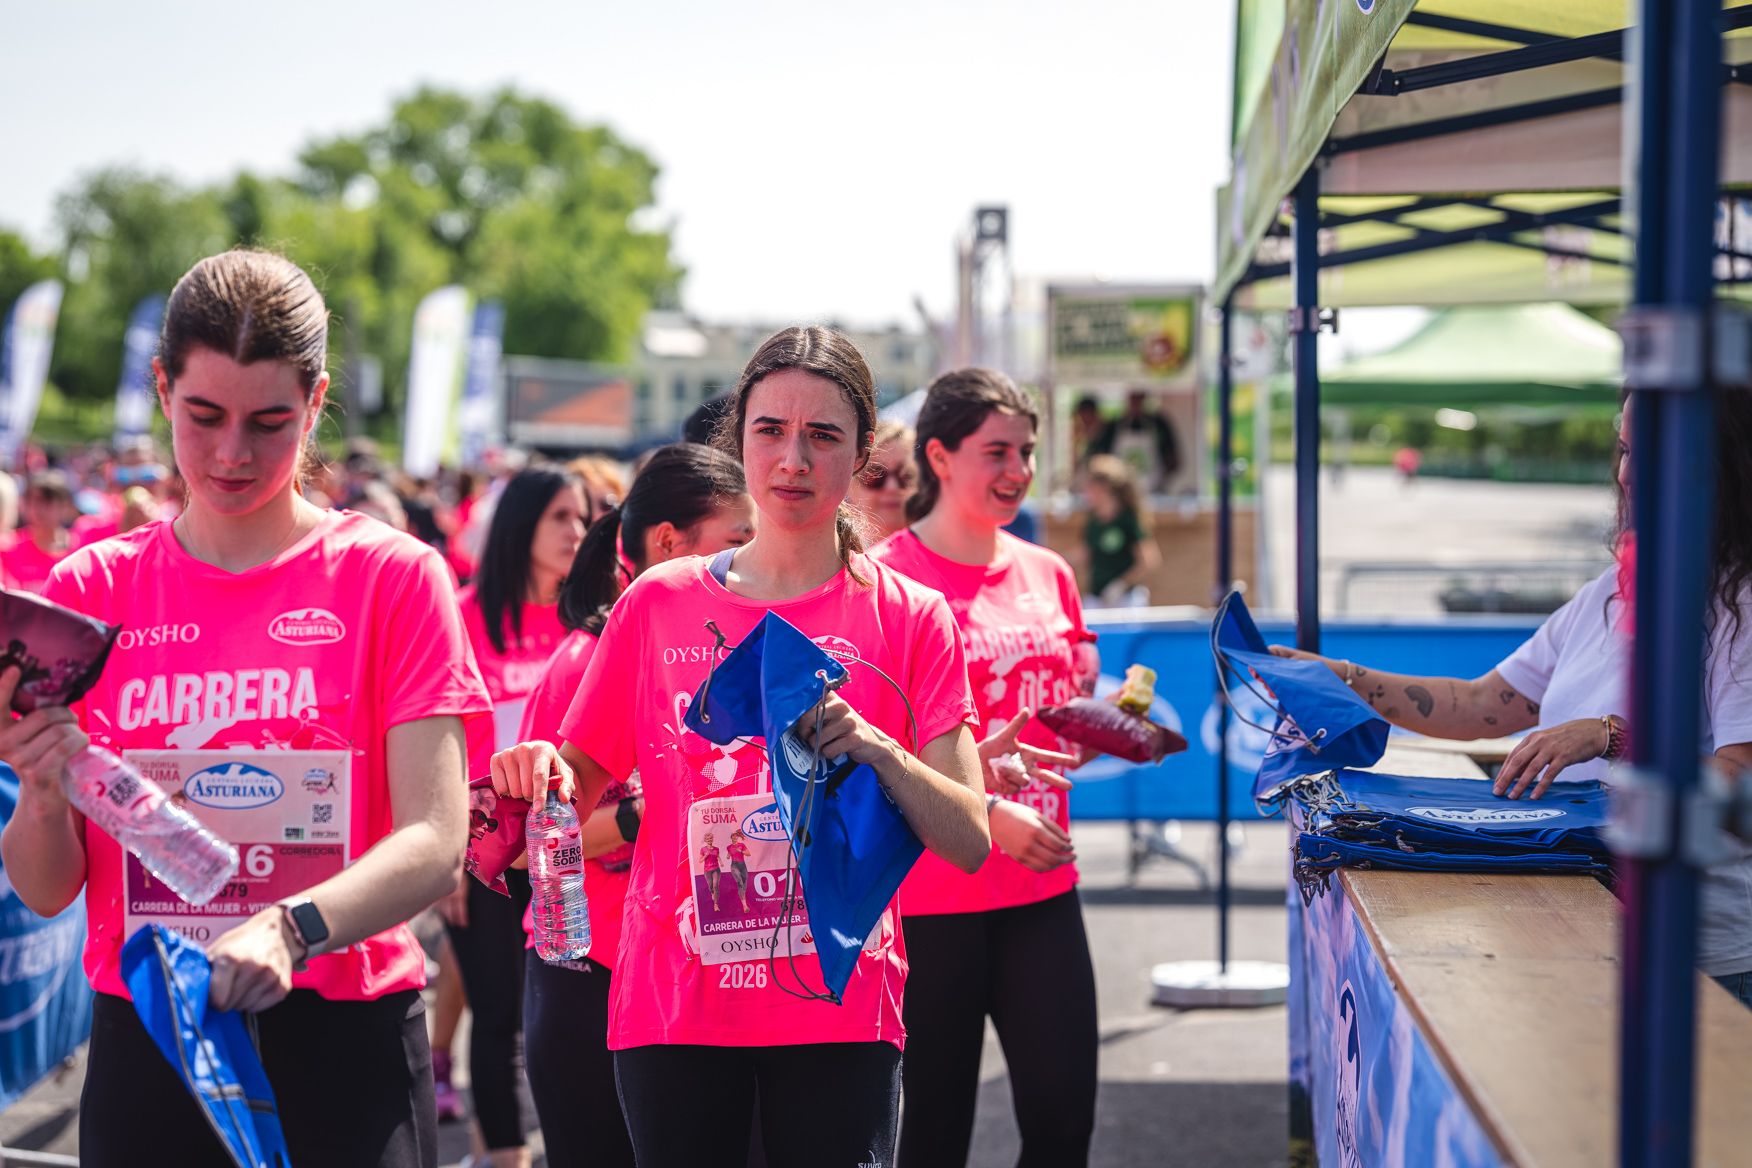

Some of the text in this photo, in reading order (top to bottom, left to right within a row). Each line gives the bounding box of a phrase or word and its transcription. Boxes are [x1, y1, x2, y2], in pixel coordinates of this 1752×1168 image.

[116, 623, 200, 650] OYSHO
[274, 620, 340, 638] ASTURIANA
[116, 667, 320, 731] CARRERA
[191, 780, 276, 798] ASTURIANA
[703, 814, 738, 825] SUMA
[1423, 810, 1551, 821] ASTURIANA
[553, 846, 582, 859] ZERO
[553, 854, 583, 867] SODIO
[753, 869, 804, 898] 01
[131, 902, 175, 914] CARRERA
[176, 902, 189, 914] DE
[190, 902, 204, 914] LA
[205, 903, 241, 914] MUJER
[703, 920, 744, 933] CARRERA
[745, 918, 757, 929] DE
[758, 917, 770, 928] LA
[721, 936, 779, 954] OYSHO
[718, 963, 768, 989] 2026
